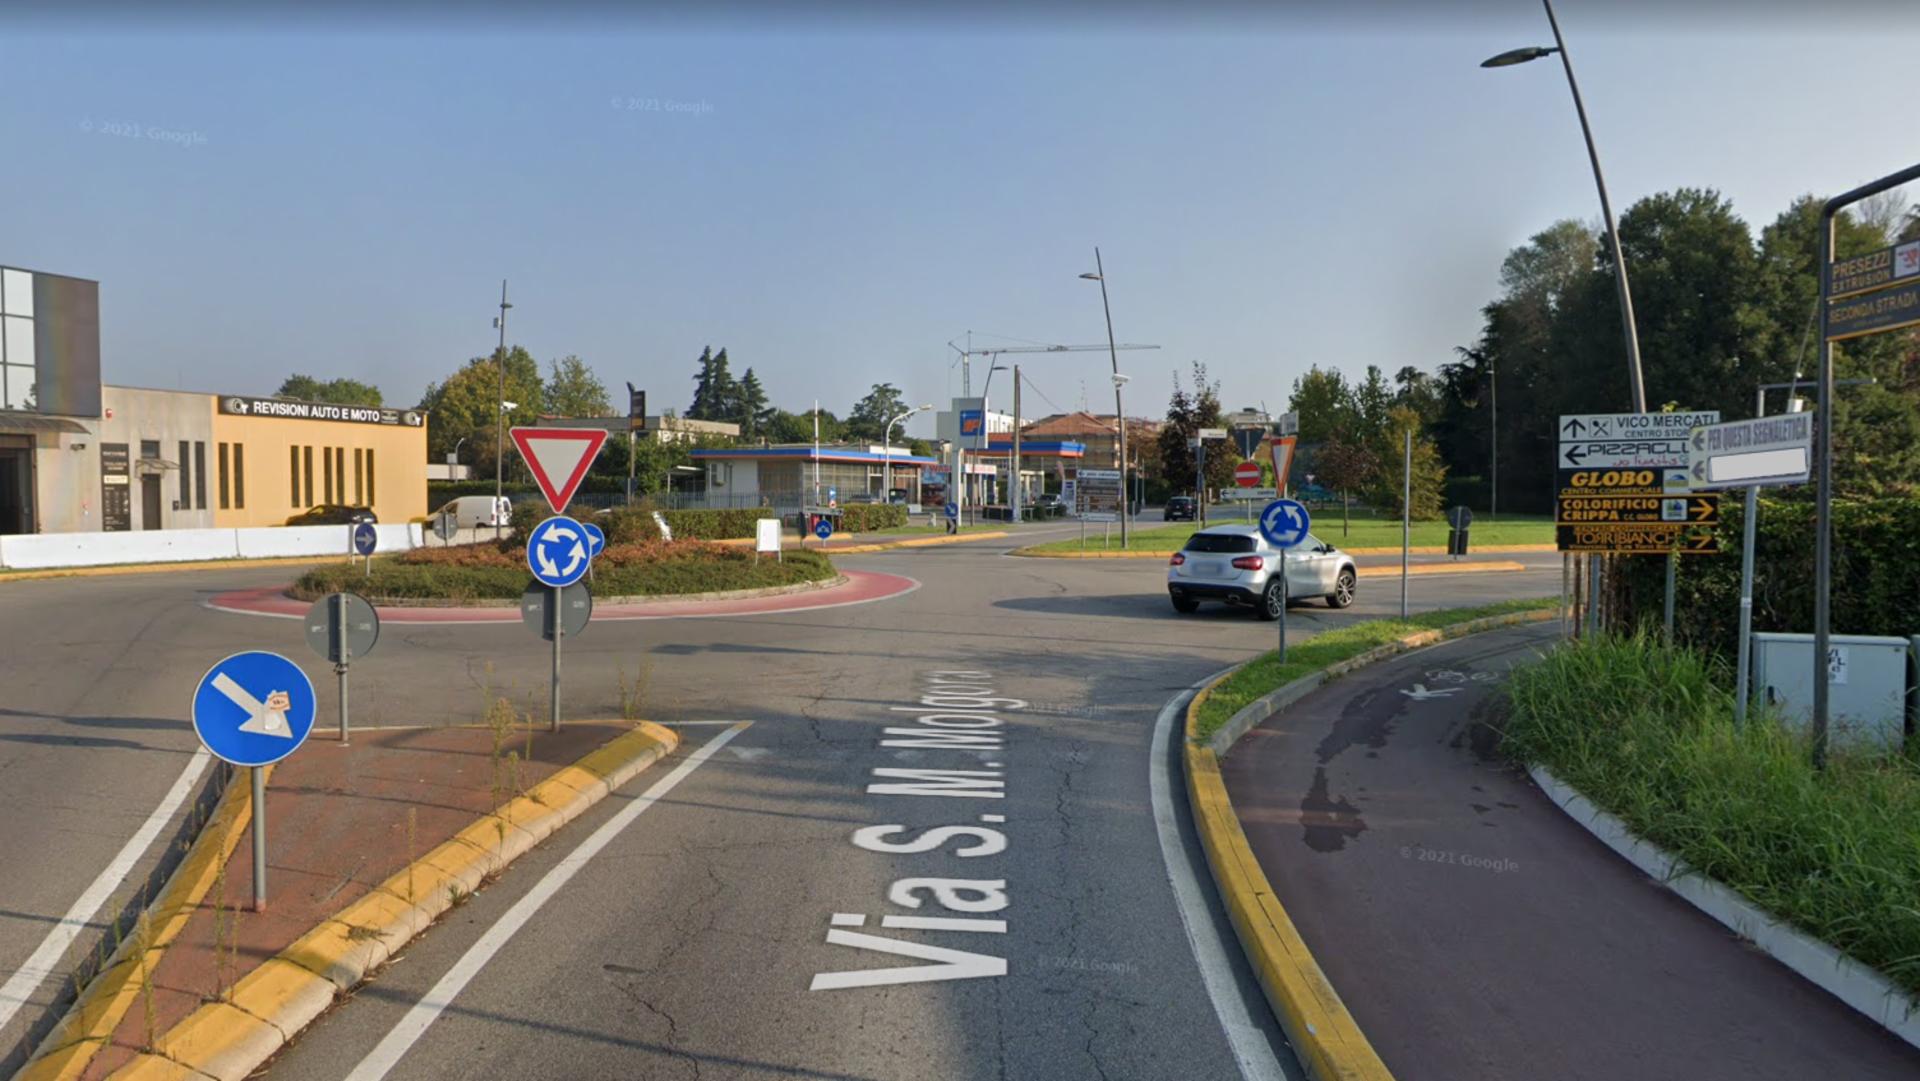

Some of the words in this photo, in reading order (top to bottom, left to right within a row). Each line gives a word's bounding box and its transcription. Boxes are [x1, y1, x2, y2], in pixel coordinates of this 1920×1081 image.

[1833, 251, 1891, 277] PRESEZZI
[1832, 270, 1890, 294] EXTRUSION
[1829, 302, 1876, 324] SECONDA
[1877, 291, 1918, 312] STRADA
[253, 401, 309, 417] REVISIONI
[311, 404, 340, 419] AUTO
[341, 408, 349, 419] E
[351, 409, 380, 422] MOTO
[1616, 416, 1649, 429] VICO
[1653, 413, 1715, 428] MERCATI
[1624, 430, 1662, 438] CENTRO
[1664, 428, 1689, 438] STOR
[1708, 428, 1721, 451] PER
[1722, 424, 1752, 450] QUESTA
[1753, 416, 1808, 446] SEGNALETICA
[1571, 470, 1655, 487] GLOBO
[1598, 487, 1662, 495] COMMERCIALE
[1562, 499, 1659, 510] COLORIFICIO
[1562, 511, 1619, 520] CRIPPA
